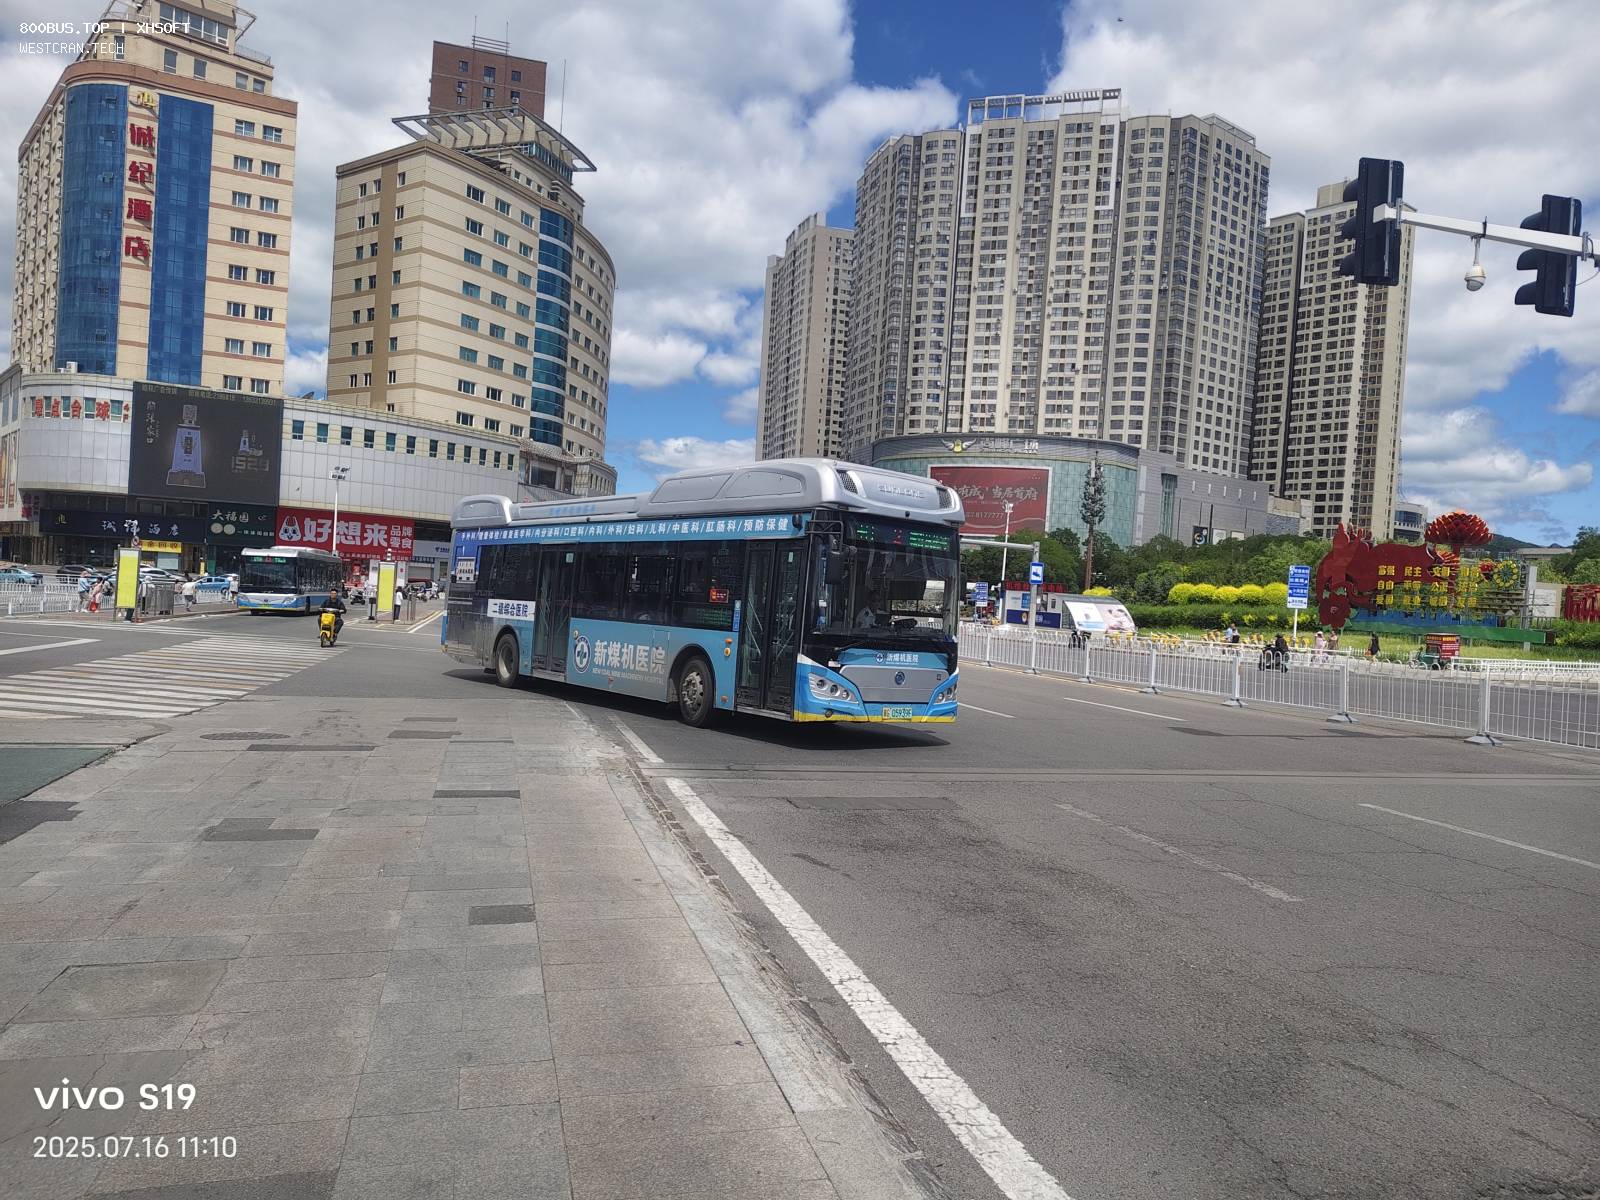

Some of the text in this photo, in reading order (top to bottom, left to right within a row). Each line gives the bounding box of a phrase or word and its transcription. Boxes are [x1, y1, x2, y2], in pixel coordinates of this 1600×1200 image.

[303, 516, 388, 547] 好想来
[390, 525, 413, 537] 品牌
[389, 537, 412, 549] 零食
[1378, 564, 1395, 576] 富强
[1404, 565, 1422, 577] 民主
[1432, 565, 1450, 577] 文明
[1377, 579, 1478, 592] 自由 平等 公正 法治
[1375, 593, 1394, 605] 爱国
[1402, 594, 1421, 606] 敬业
[1457, 596, 1477, 608] 友善
[593, 640, 666, 674] 新煤机医院
